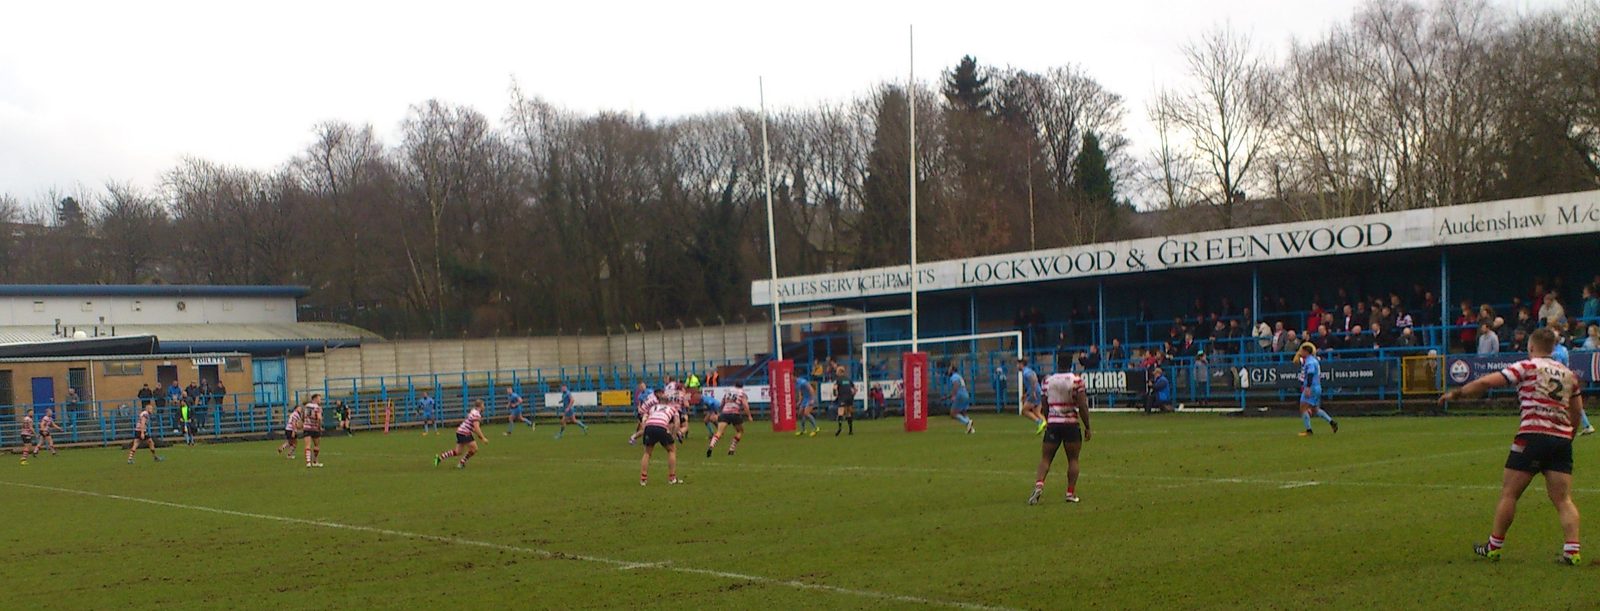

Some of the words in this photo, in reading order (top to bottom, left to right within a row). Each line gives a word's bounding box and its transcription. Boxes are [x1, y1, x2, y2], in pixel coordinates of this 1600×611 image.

[1438, 211, 1546, 236] Audenshaw
[961, 250, 1116, 284] LOCKWOOD
[1126, 248, 1145, 268] &
[1157, 221, 1393, 266] GREENWOOD
[776, 281, 817, 297] SALES
[820, 275, 882, 294] SERVICE
[886, 269, 936, 288] PARTS
[195, 356, 224, 364] TOILETS
[1474, 362, 1486, 370] The
[1081, 371, 1127, 388] arama
[1251, 367, 1277, 382] GJS
[1545, 367, 1565, 378] CLAY
[1548, 377, 1563, 402] 2
